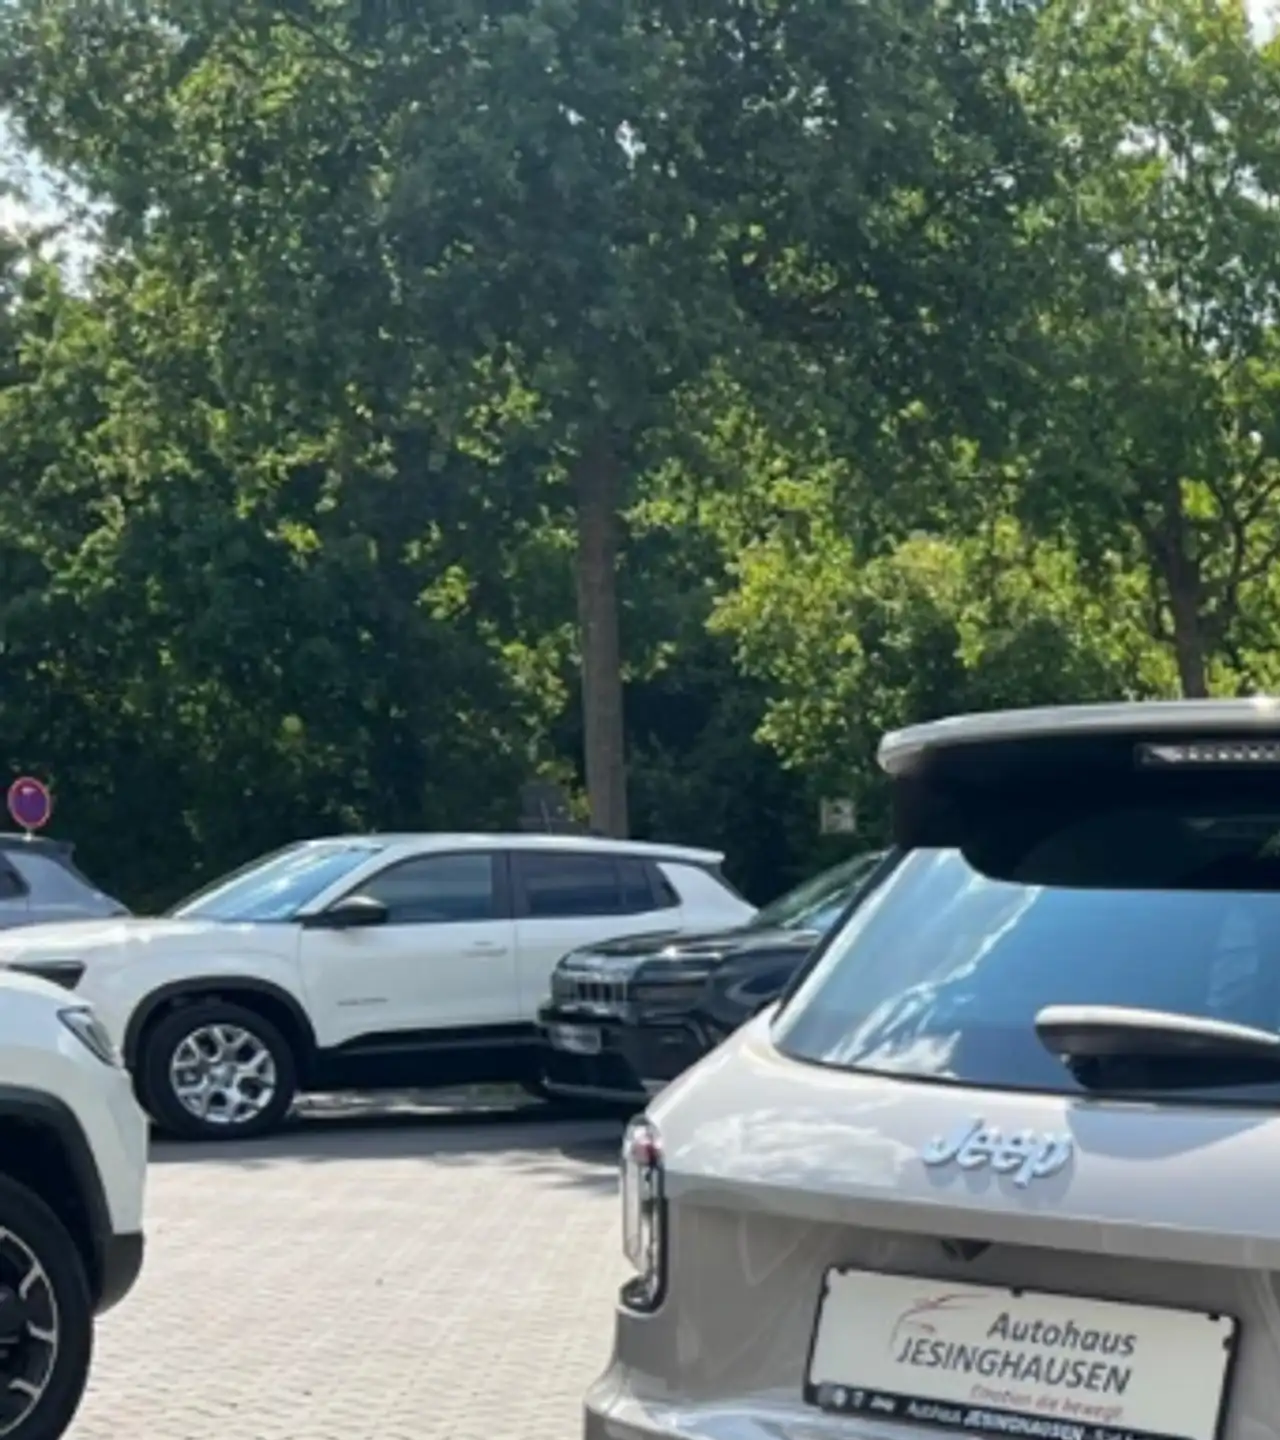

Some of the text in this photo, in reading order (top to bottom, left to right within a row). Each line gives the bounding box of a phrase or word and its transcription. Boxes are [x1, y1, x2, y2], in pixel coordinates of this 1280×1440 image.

[922, 1112, 1074, 1190] Jeep
[986, 1311, 1138, 1356] Autohaus
[896, 1336, 1133, 1395] JESINGHAUSEN
